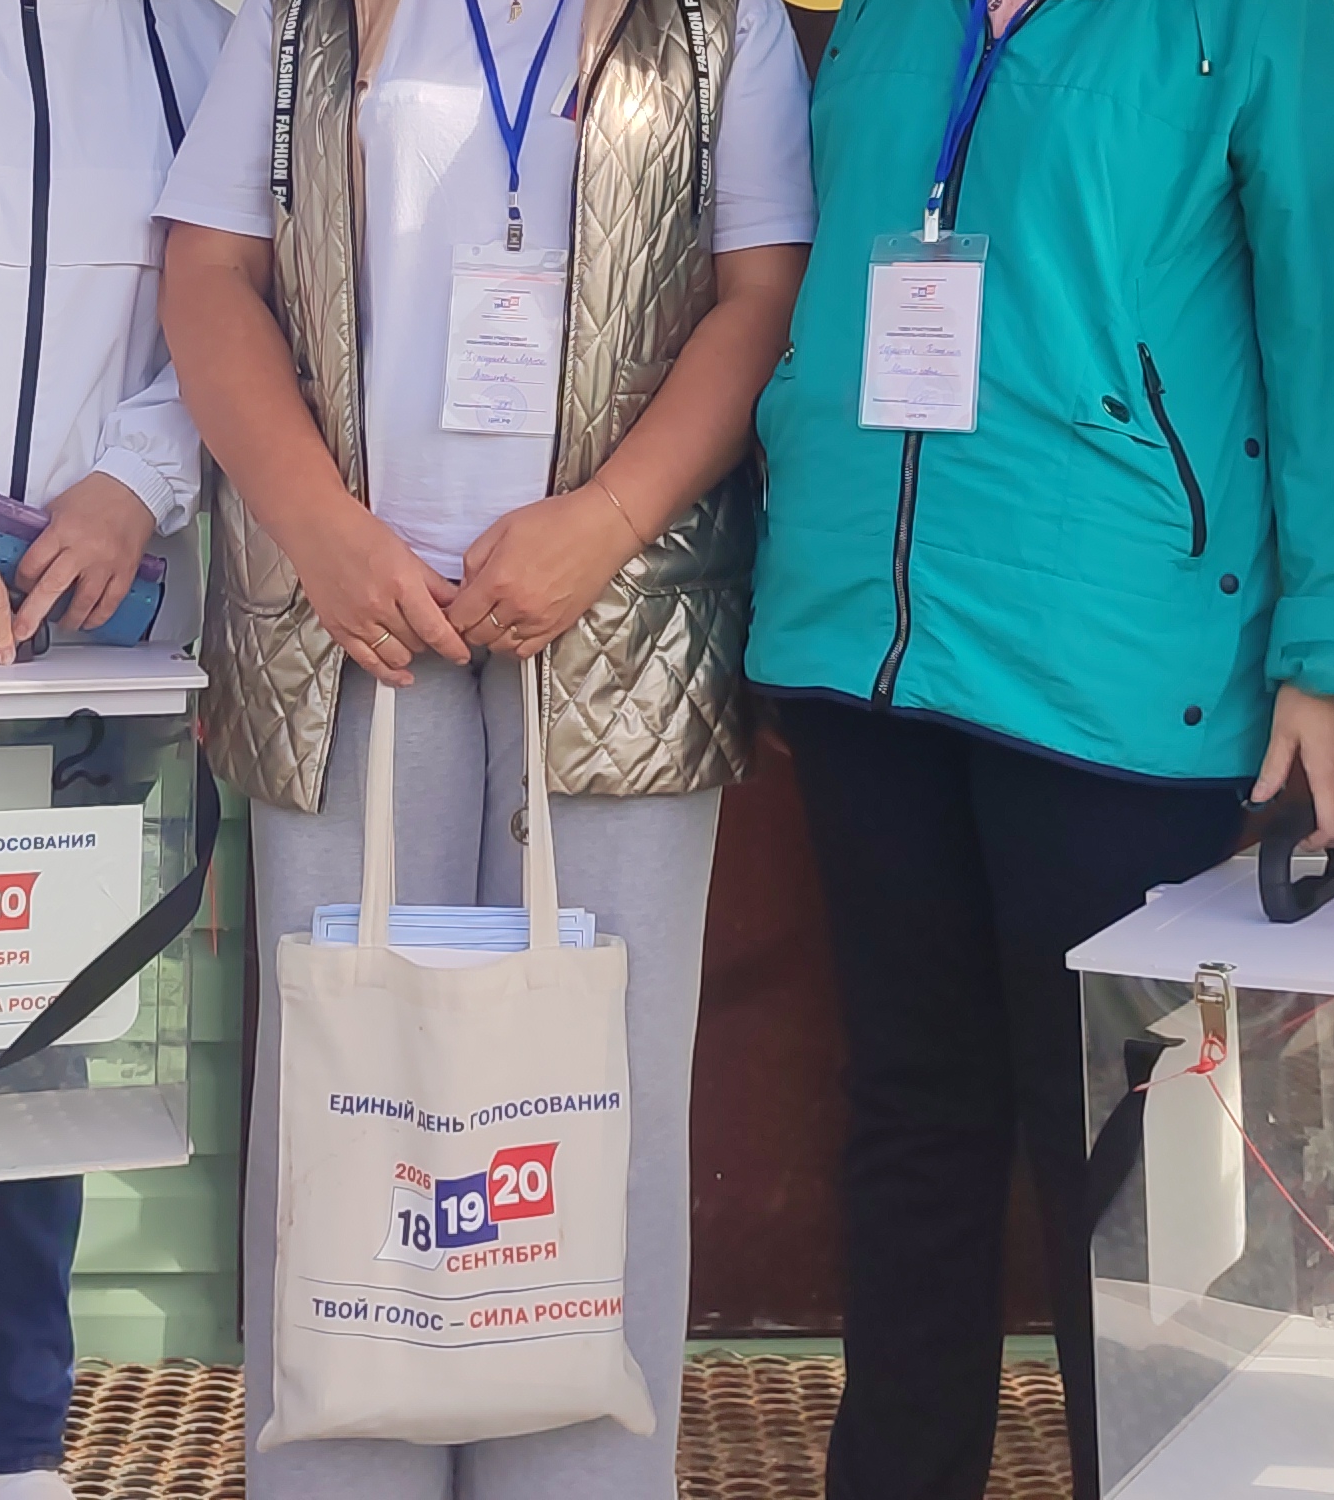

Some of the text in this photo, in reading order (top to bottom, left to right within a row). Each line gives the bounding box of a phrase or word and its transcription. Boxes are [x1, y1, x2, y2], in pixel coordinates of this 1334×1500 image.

[687, 11, 708, 73] FASHION
[277, 45, 294, 109] FASHION
[698, 77, 710, 143] FASHION
[273, 114, 291, 180] FASHION
[330, 1092, 620, 1133] ЕДИНЫЙ ДЕНЬ ГОЛОСОВАНИЯ
[394, 1163, 431, 1190] 2026
[398, 1161, 548, 1252] 18 19 20
[446, 1241, 557, 1273] СЕНТЯБРЯ
[312, 1297, 368, 1320] ТВОЙ
[374, 1305, 444, 1331] ГОЛОС
[470, 1307, 529, 1328] СИЛА
[534, 1297, 622, 1322] РОССИИ
